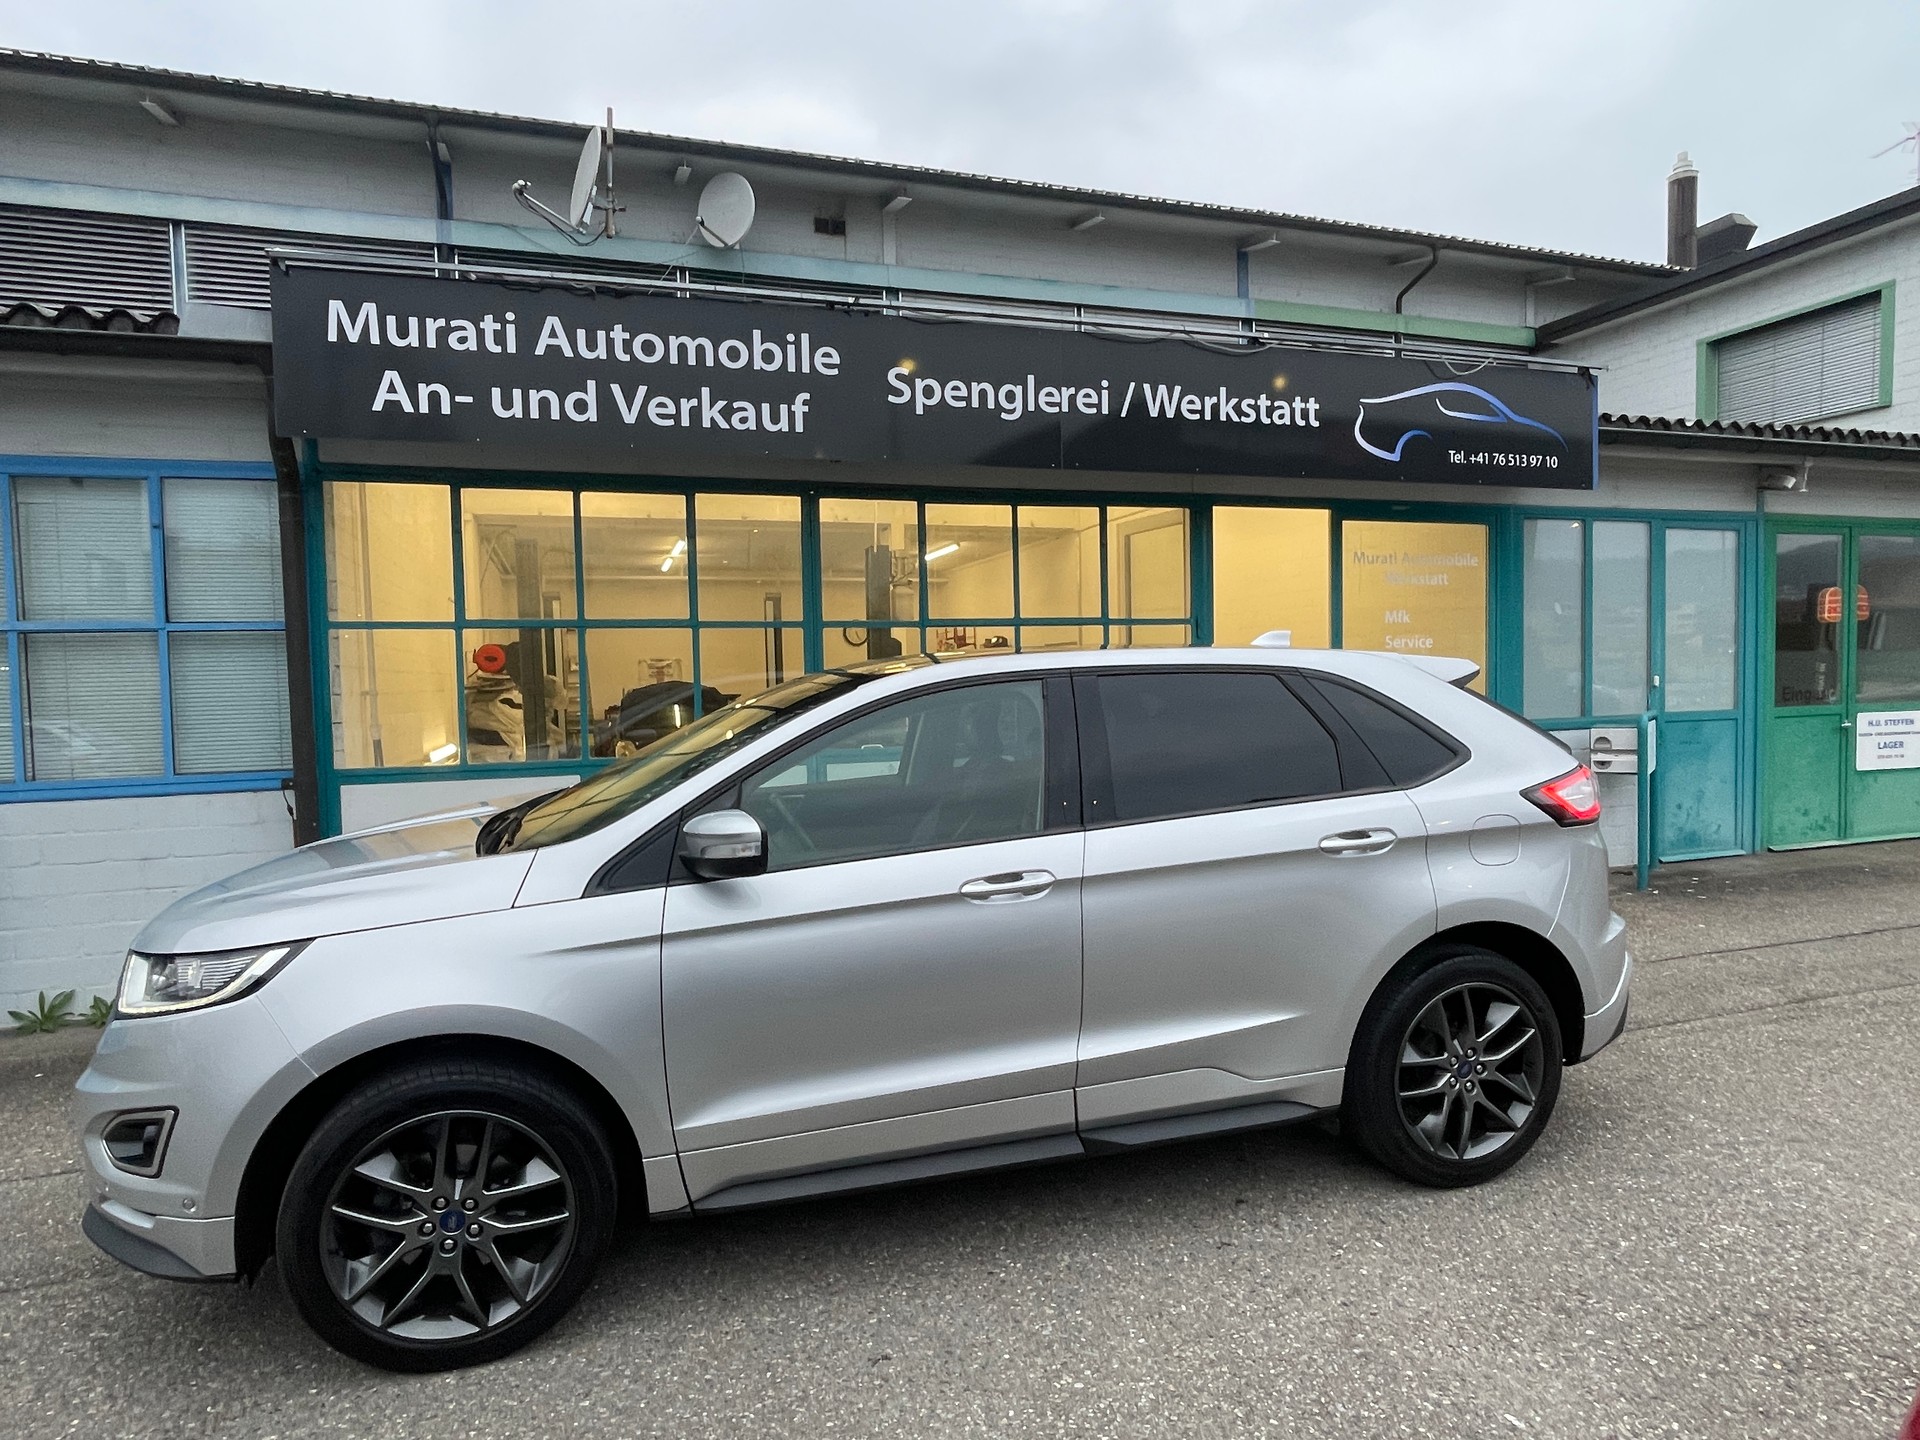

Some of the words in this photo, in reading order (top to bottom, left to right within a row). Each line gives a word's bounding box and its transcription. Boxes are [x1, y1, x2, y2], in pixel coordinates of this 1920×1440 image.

[327, 299, 517, 354] Murati
[534, 315, 841, 376] Automobile
[371, 369, 474, 415] An-
[491, 379, 598, 422] und
[609, 383, 811, 433] Verkauf
[887, 366, 1110, 420] Spenglerei
[1142, 382, 1320, 428] Werkstatt
[1448, 450, 1467, 464] Tel.
[1469, 452, 1489, 465] +41
[1492, 453, 1506, 466] 76
[1508, 453, 1528, 467] 513
[1529, 454, 1543, 467] 97
[1545, 455, 1559, 469] 10
[1353, 551, 1398, 565] Murati
[1402, 552, 1479, 567] Amobile
[1384, 571, 1449, 586] kstatt
[1384, 635, 1434, 649] Service
[1877, 741, 1904, 750] LAGER
